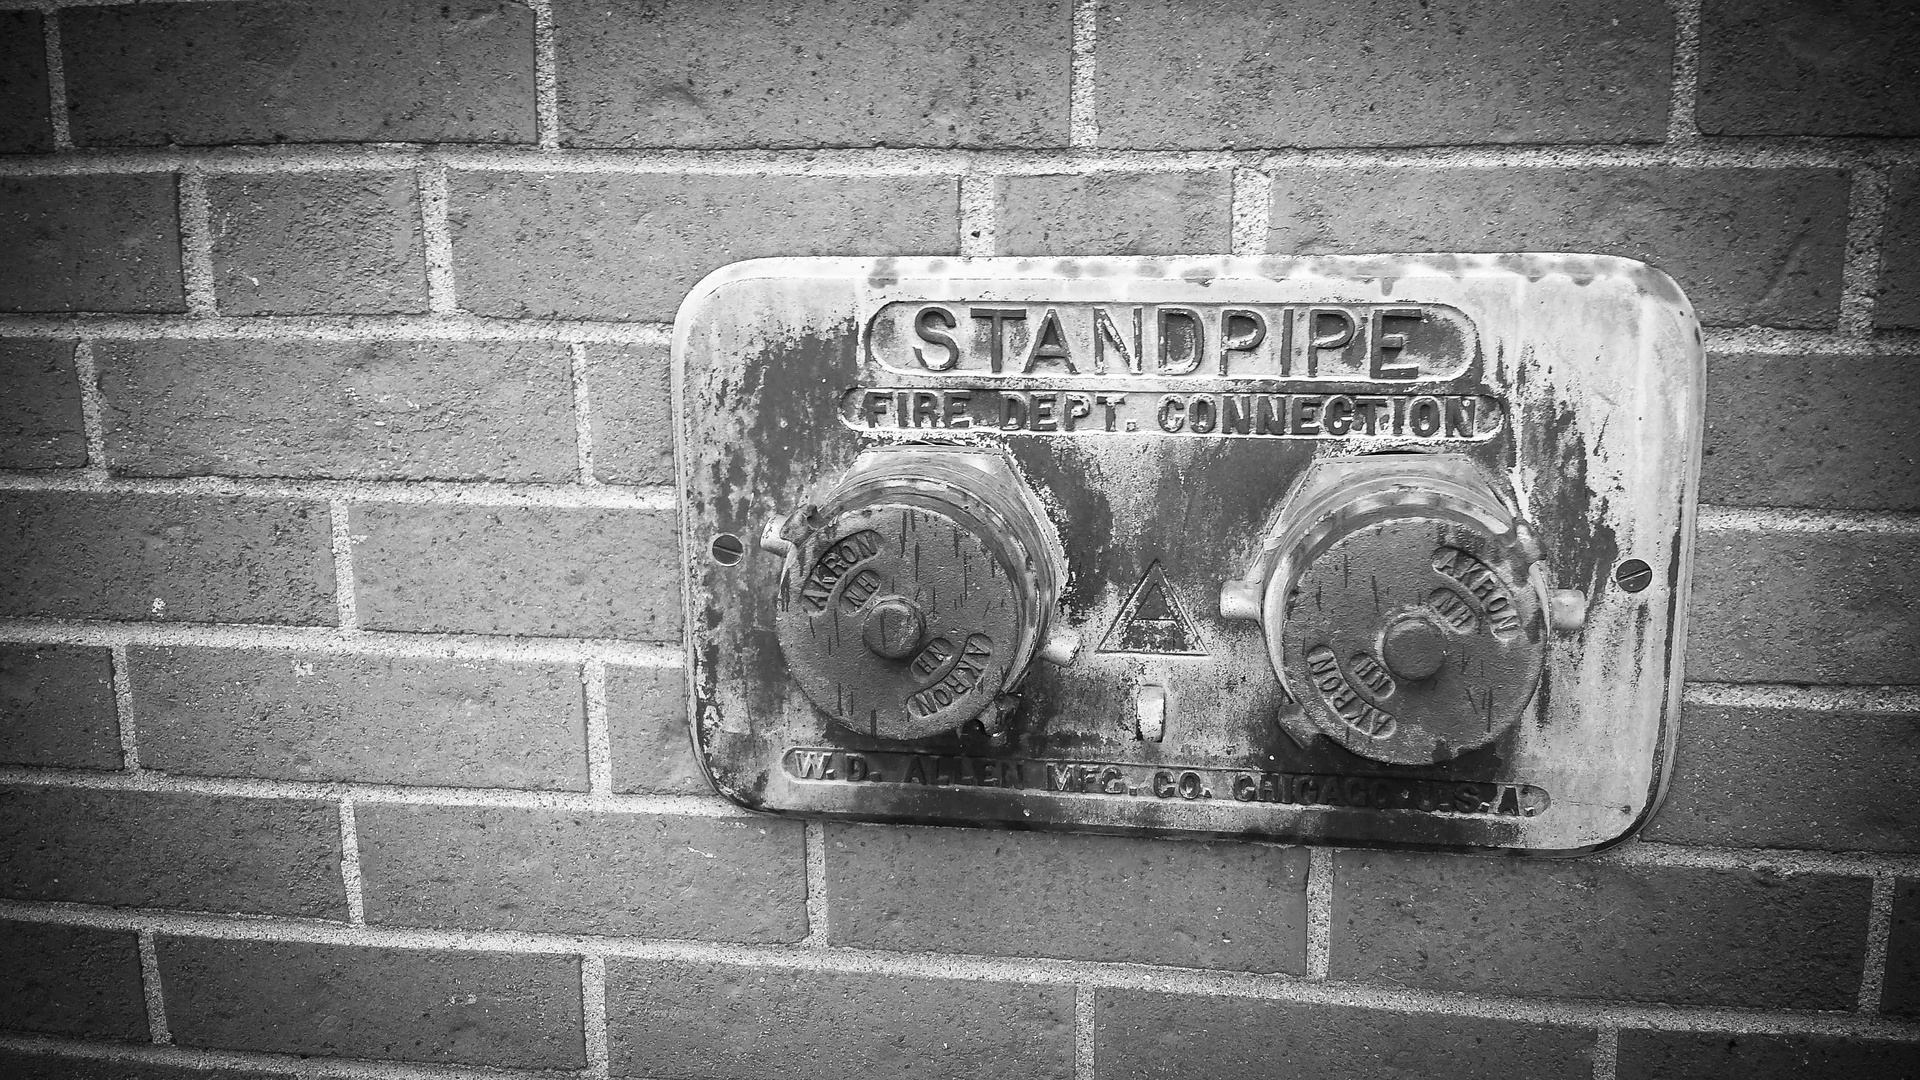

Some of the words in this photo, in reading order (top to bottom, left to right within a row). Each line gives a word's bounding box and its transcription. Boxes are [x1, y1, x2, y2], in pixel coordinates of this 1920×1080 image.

[912, 306, 1423, 379] STANDPIPE
[867, 389, 969, 430] FIRE
[1000, 391, 1139, 433] DEPT.
[1157, 393, 1477, 438] CONNECTION
[803, 534, 880, 611] AKRON
[848, 574, 880, 610] NH
[1433, 549, 1521, 633] AKRON
[1435, 595, 1475, 629] NH
[915, 640, 991, 717] AKRON
[916, 643, 953, 676] NH
[1353, 658, 1394, 693] NH
[1309, 651, 1393, 736] AKRON
[795, 751, 835, 781] W.
[846, 753, 882, 782] D.
[903, 755, 1025, 790] ALLEN
[1046, 762, 1138, 797] MFG.
[1152, 770, 1213, 800] CO.
[1231, 772, 1394, 810] CHICAGO
